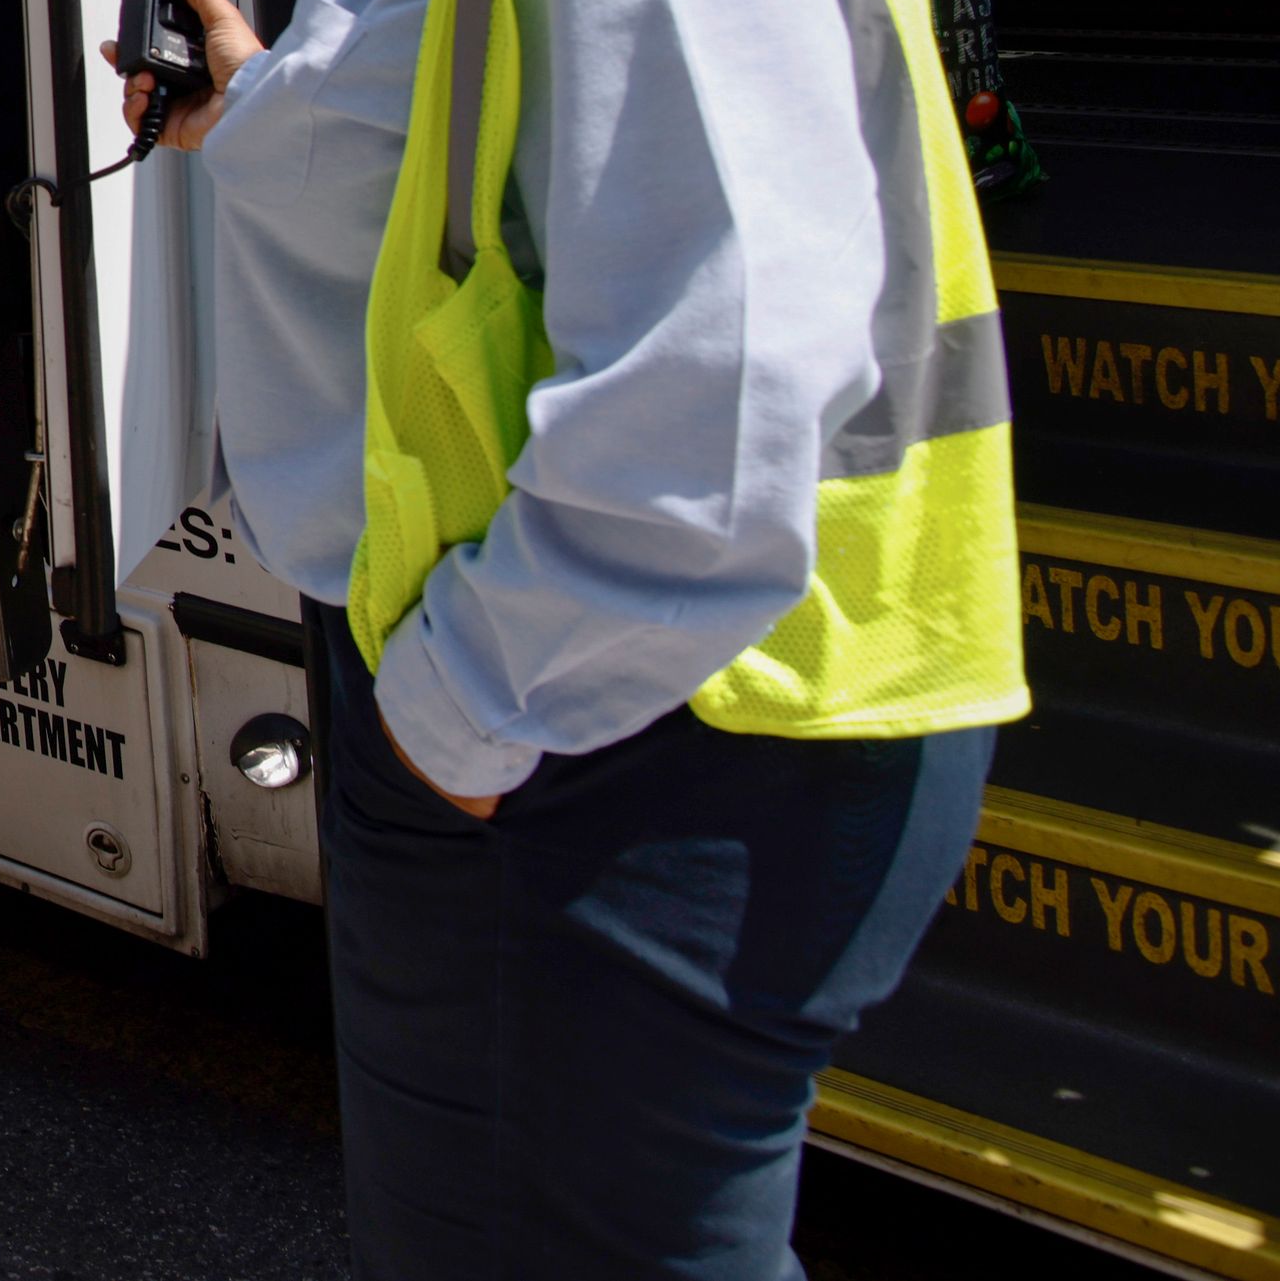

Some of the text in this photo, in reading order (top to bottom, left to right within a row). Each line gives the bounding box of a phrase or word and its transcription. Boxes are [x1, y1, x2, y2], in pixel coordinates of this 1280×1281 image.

[1040, 332, 1231, 416] WATCH
[1022, 562, 1166, 652] ATCH
[944, 846, 1275, 997] TCH YOUR
